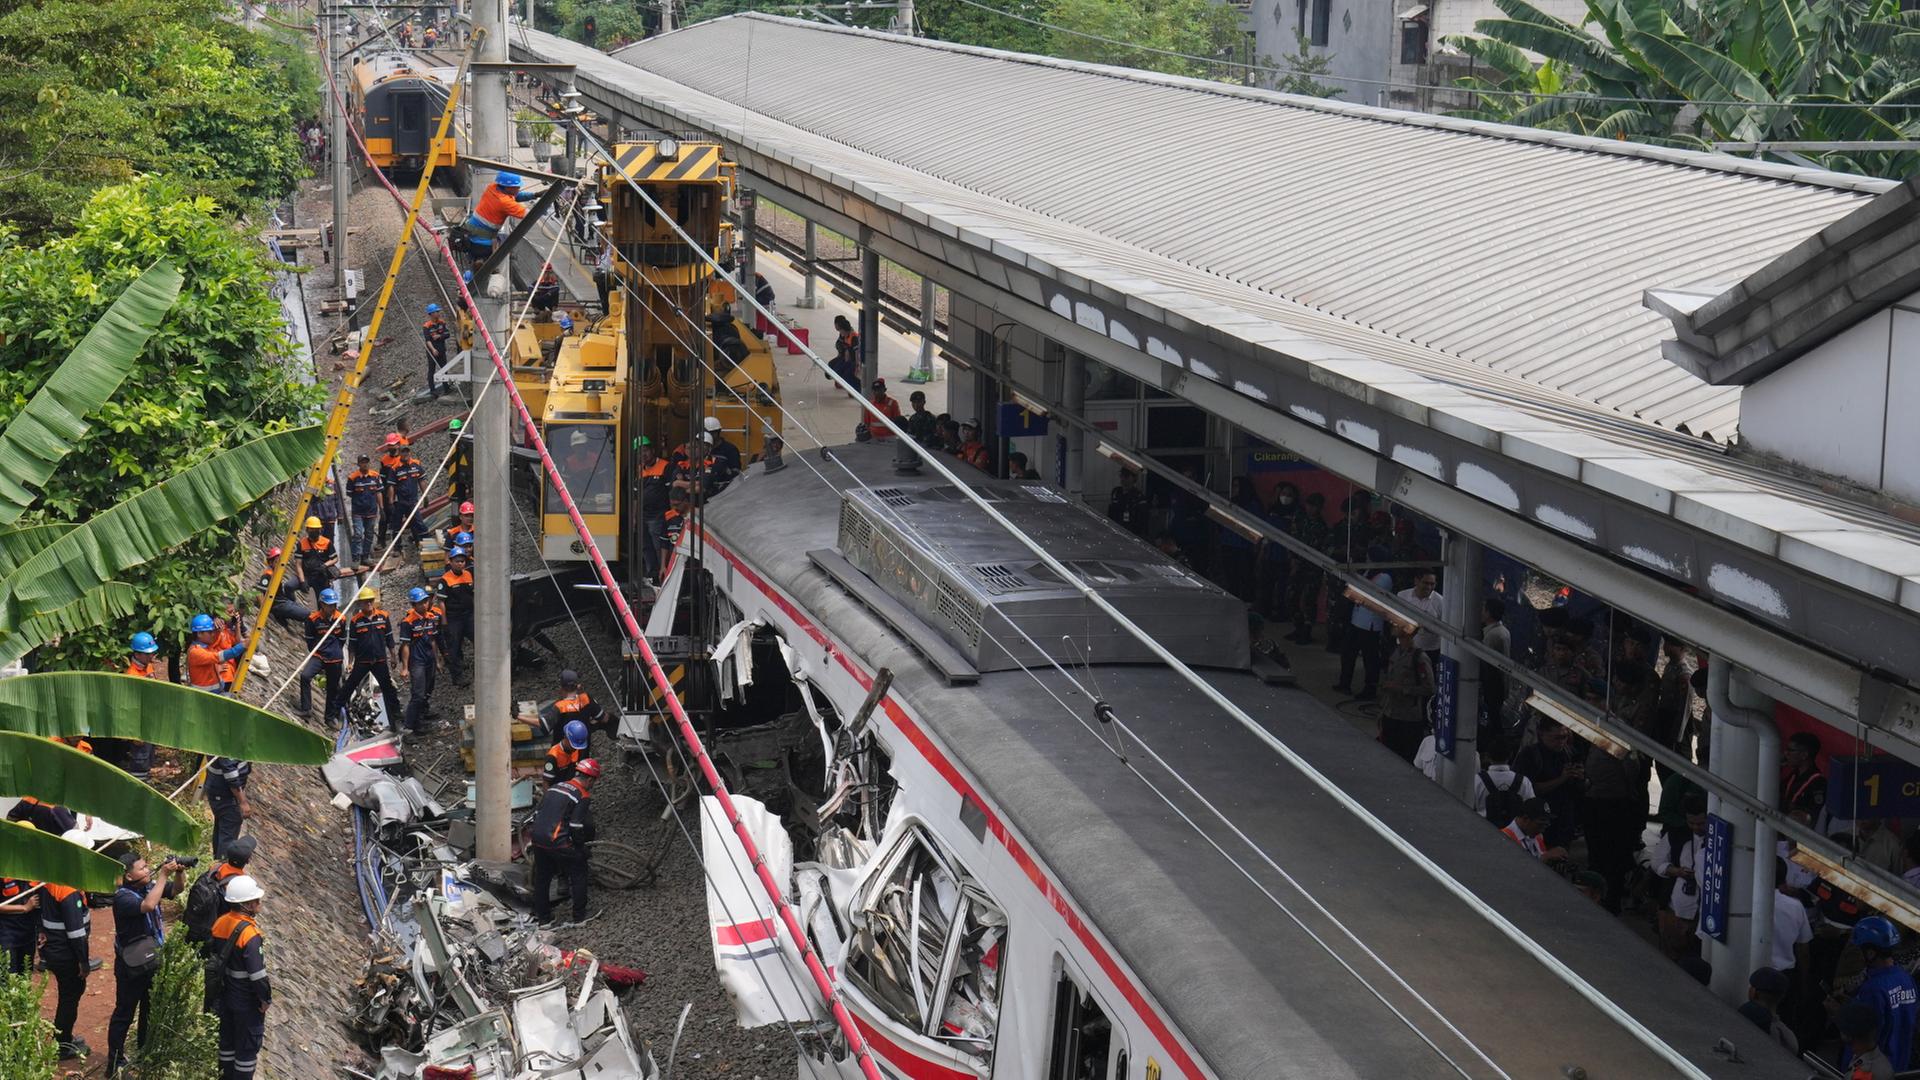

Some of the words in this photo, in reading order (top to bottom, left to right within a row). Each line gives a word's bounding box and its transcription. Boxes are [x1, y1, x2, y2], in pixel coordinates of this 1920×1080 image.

[1019, 408, 1030, 429] 1
[1863, 774, 1880, 807] 1
[1705, 823, 1714, 905] BEKASI
[1713, 835, 1723, 904] TIMUR
